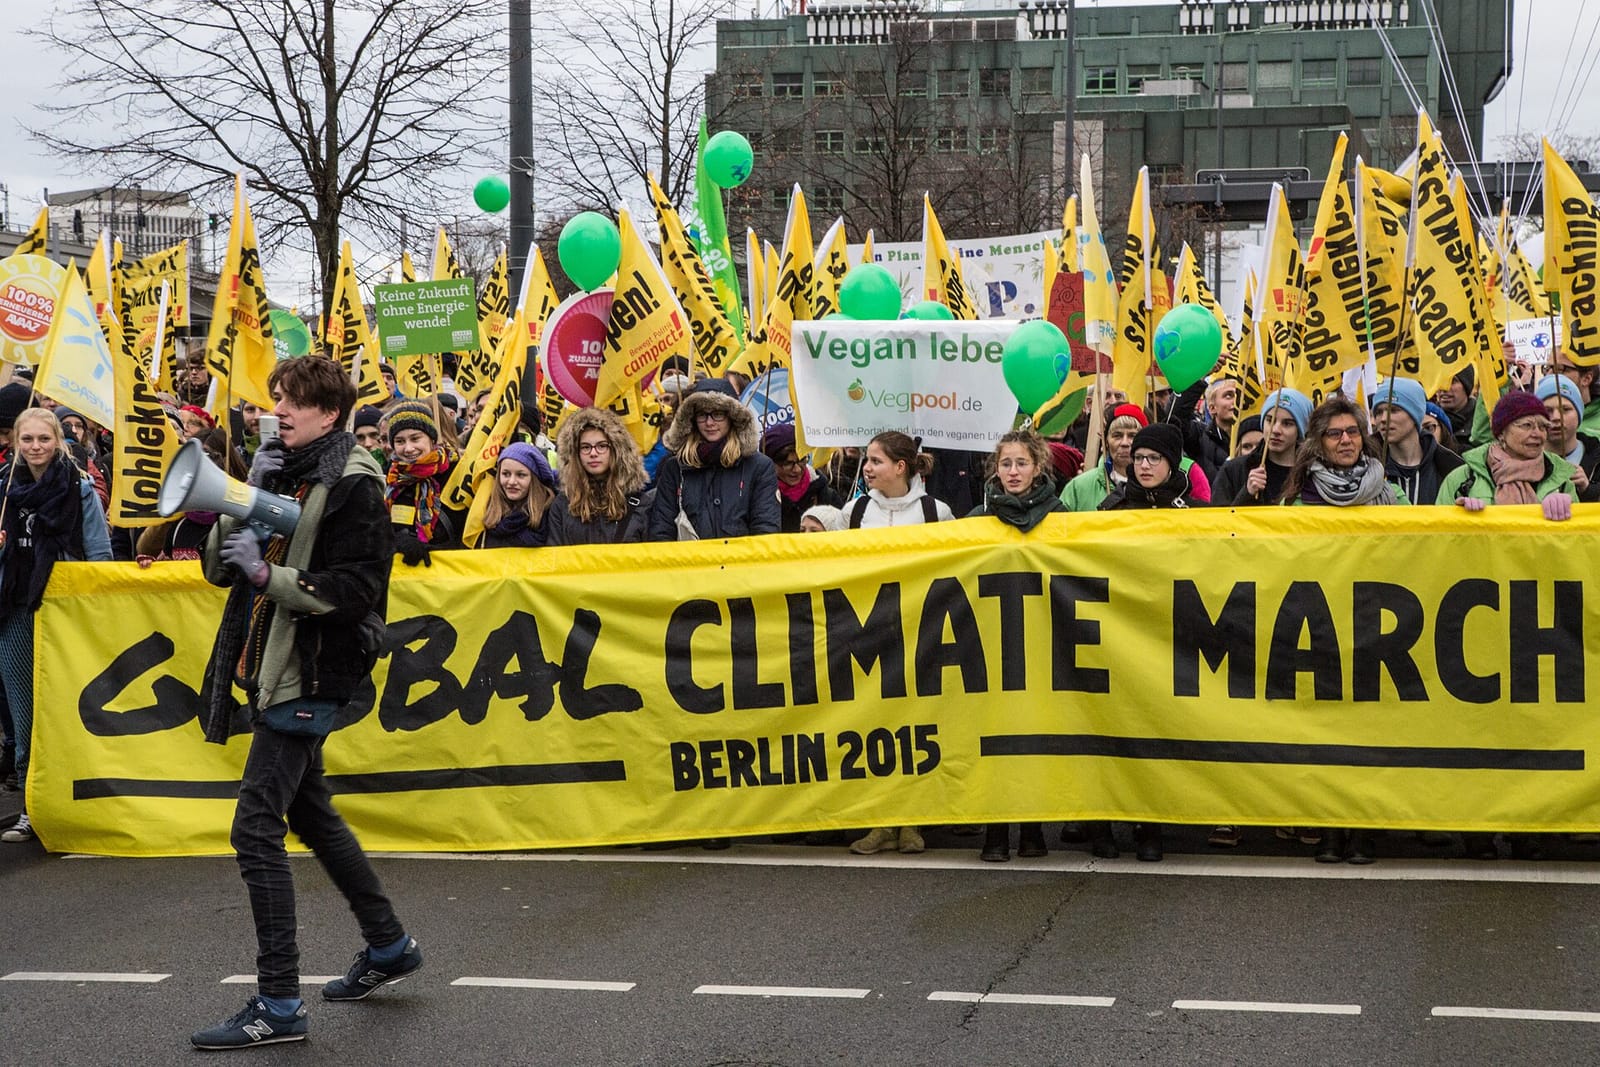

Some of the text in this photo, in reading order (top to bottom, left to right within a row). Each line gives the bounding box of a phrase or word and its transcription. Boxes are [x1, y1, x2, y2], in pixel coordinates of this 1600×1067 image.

[1561, 196, 1600, 358] Fracking
[8, 285, 53, 314] 100%
[378, 284, 470, 302] Keine Zukunft
[382, 300, 470, 317] ohne Energie-
[5, 313, 41, 333] AVAAZ
[403, 315, 451, 329] wende!
[623, 310, 684, 377] campact!
[802, 330, 917, 368] Vegan
[930, 332, 1004, 363] lebe
[868, 390, 983, 413] Vegpool.de
[806, 426, 821, 435] Das
[823, 426, 885, 436] Online-Portal
[911, 427, 925, 436] um
[927, 427, 944, 437] den
[945, 432, 985, 441] veganen
[665, 571, 1110, 714] CLIMATE
[1173, 578, 1585, 704] MARCH
[670, 724, 942, 792] BERLIN 2015
